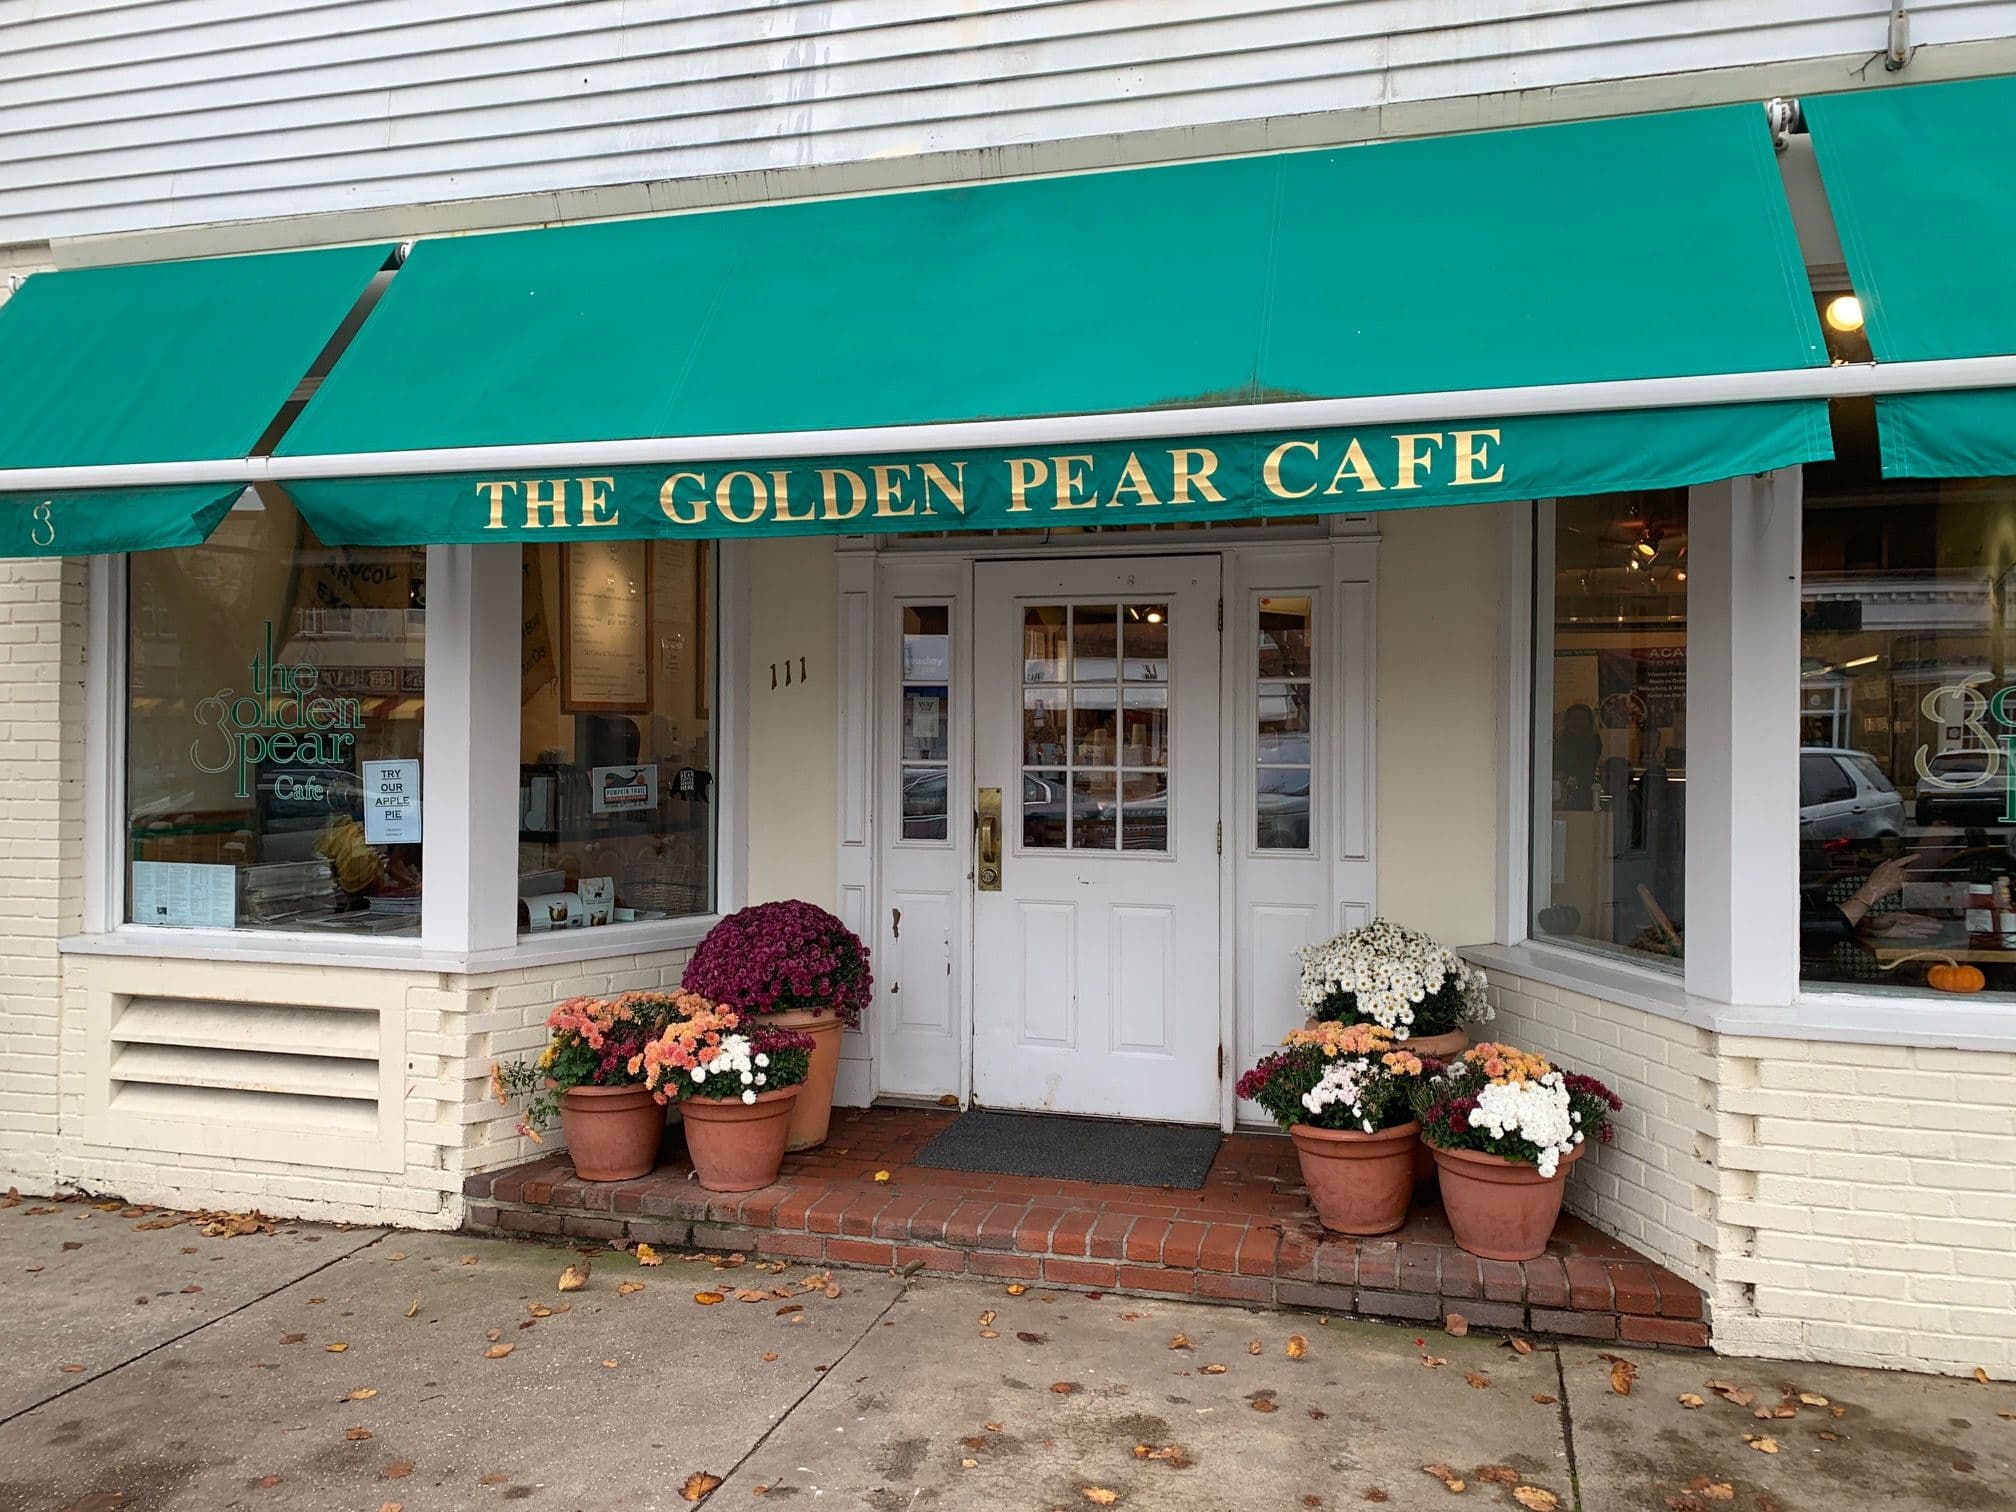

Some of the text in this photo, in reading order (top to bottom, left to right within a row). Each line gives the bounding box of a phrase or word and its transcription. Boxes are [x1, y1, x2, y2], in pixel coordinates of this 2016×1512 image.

[476, 428, 1506, 529] THE GOLDEN PEAR CAFE
[248, 621, 319, 695] the
[769, 656, 808, 691] 111
[234, 732, 355, 798] pear
[381, 769, 401, 779] TRY
[274, 775, 324, 801] Cafe
[381, 783, 403, 792] OUR
[375, 796, 410, 806] APPLE
[385, 810, 402, 819] PIE
